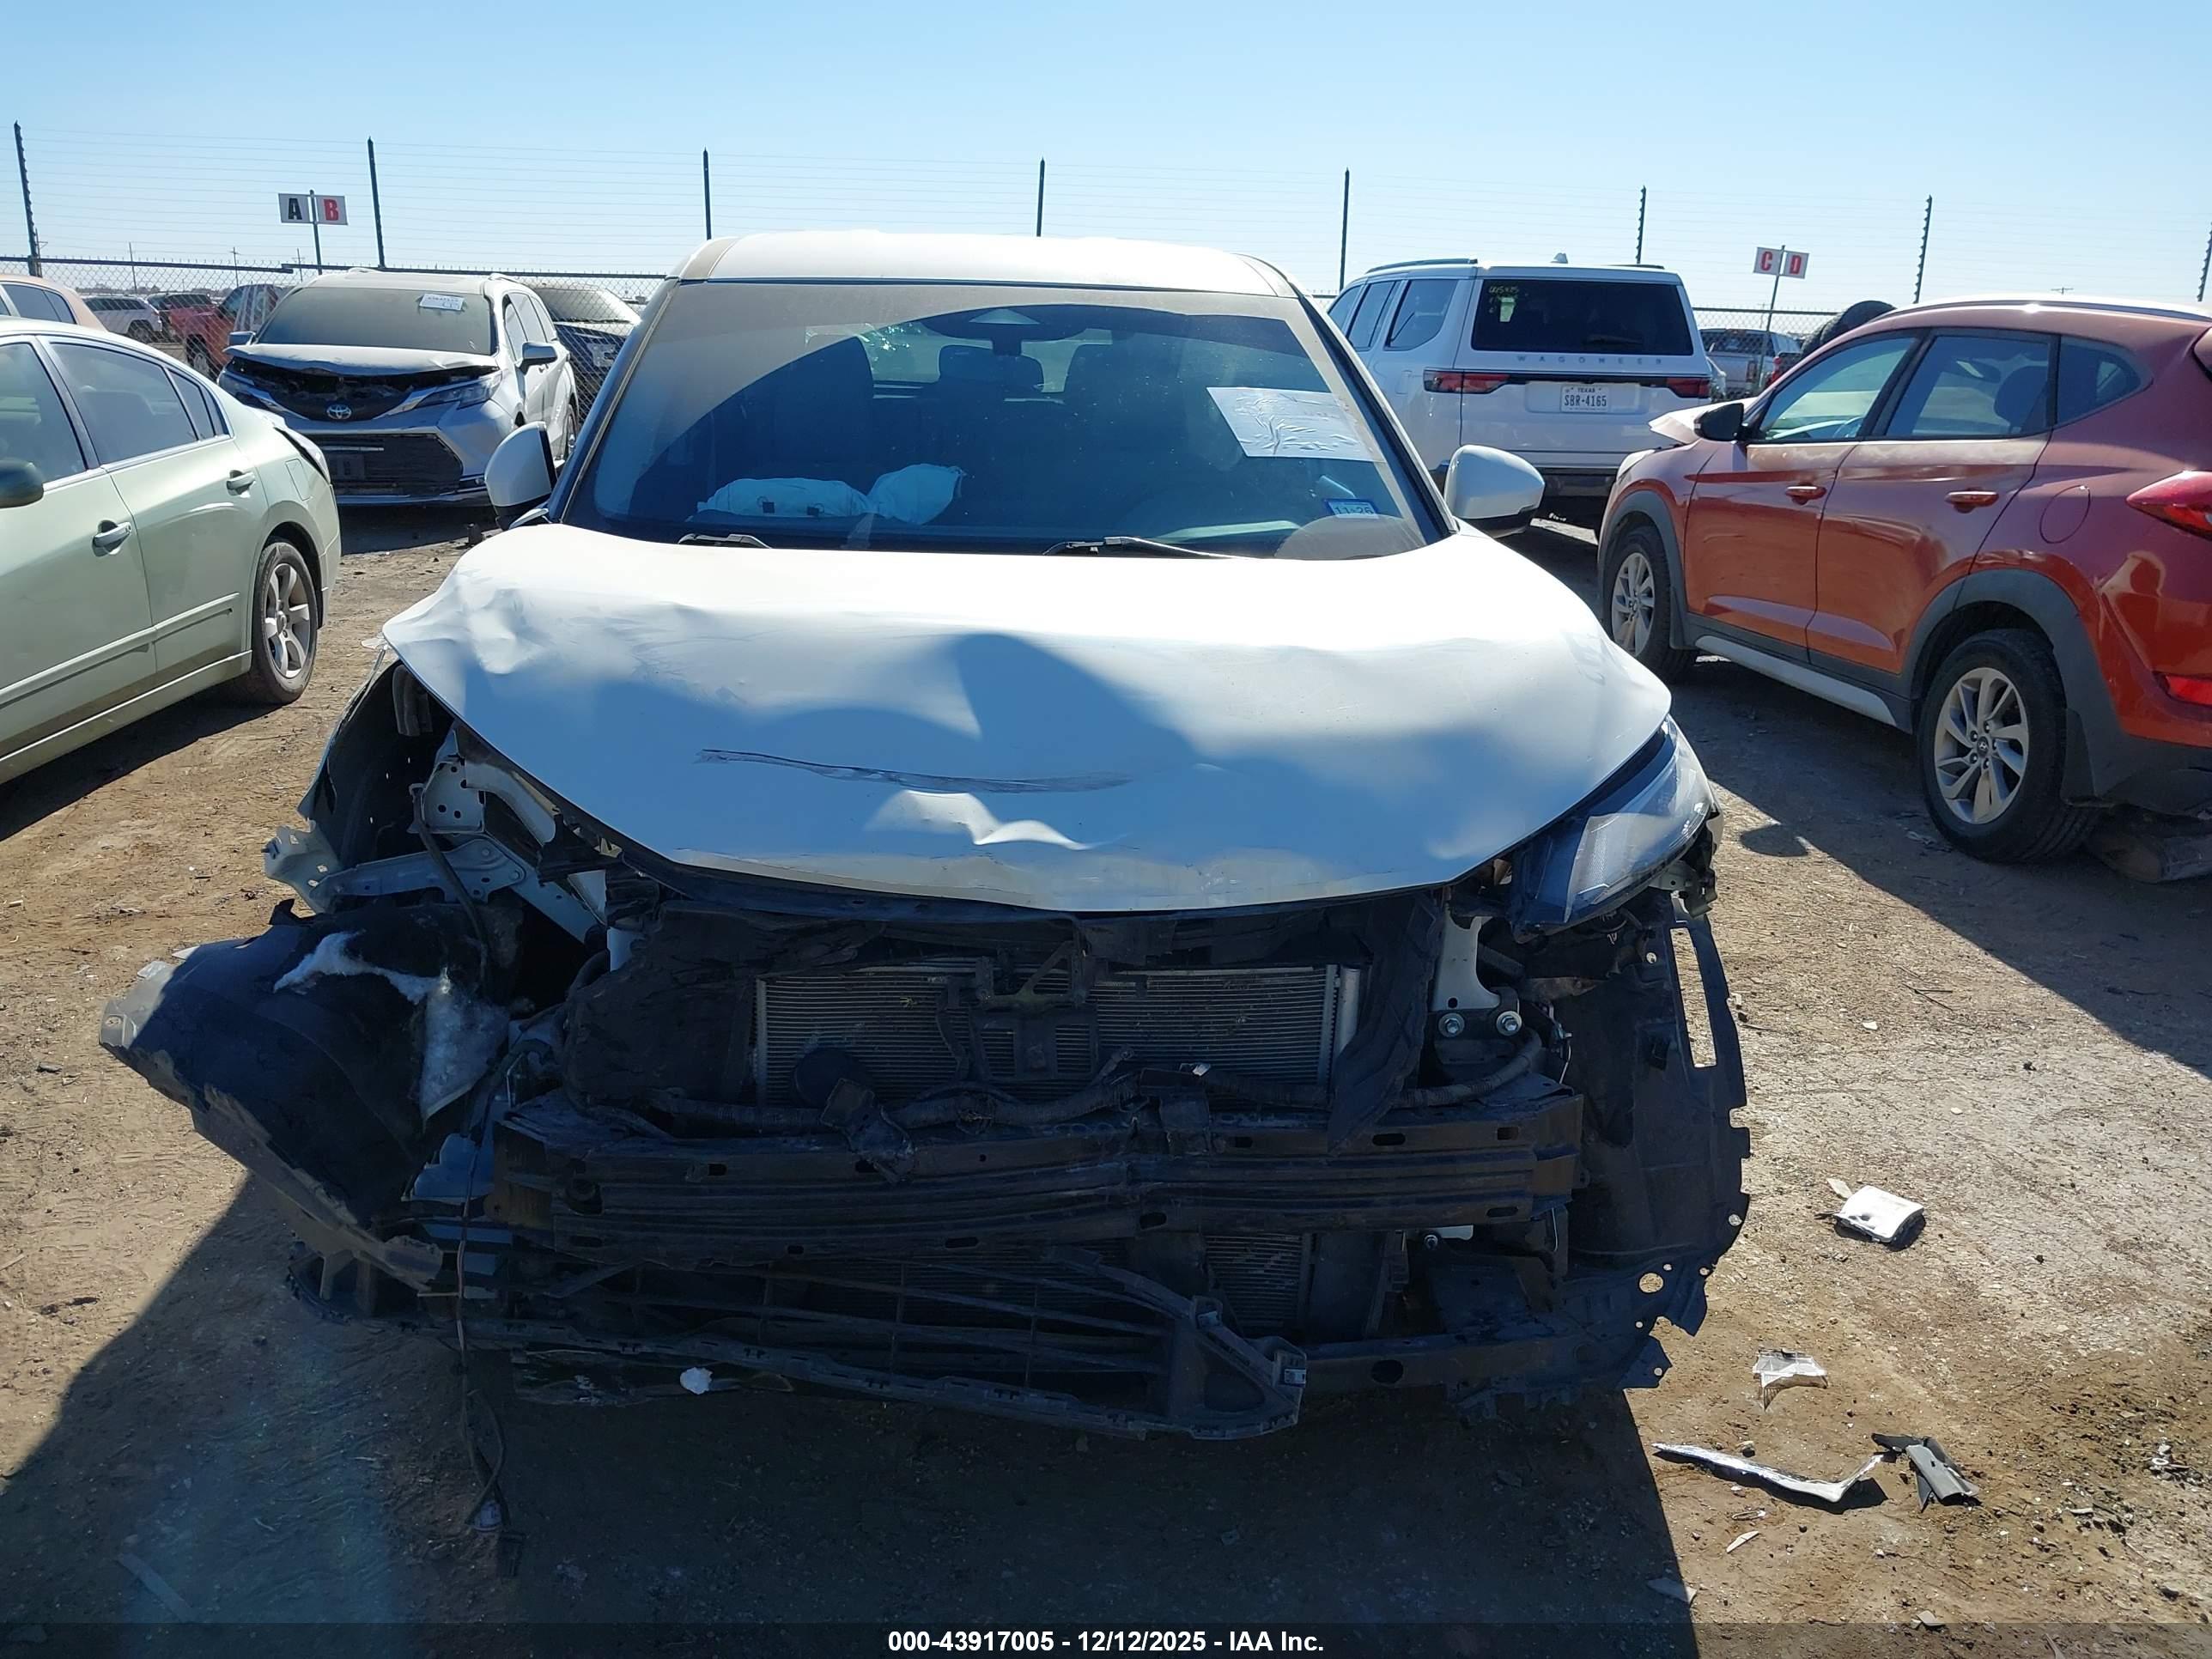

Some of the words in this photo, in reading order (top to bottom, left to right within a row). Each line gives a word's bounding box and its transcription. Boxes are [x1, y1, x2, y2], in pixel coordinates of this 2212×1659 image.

[288, 198, 303, 221] A
[323, 198, 339, 222] B
[1760, 251, 1773, 271] C
[1789, 254, 1802, 275] D
